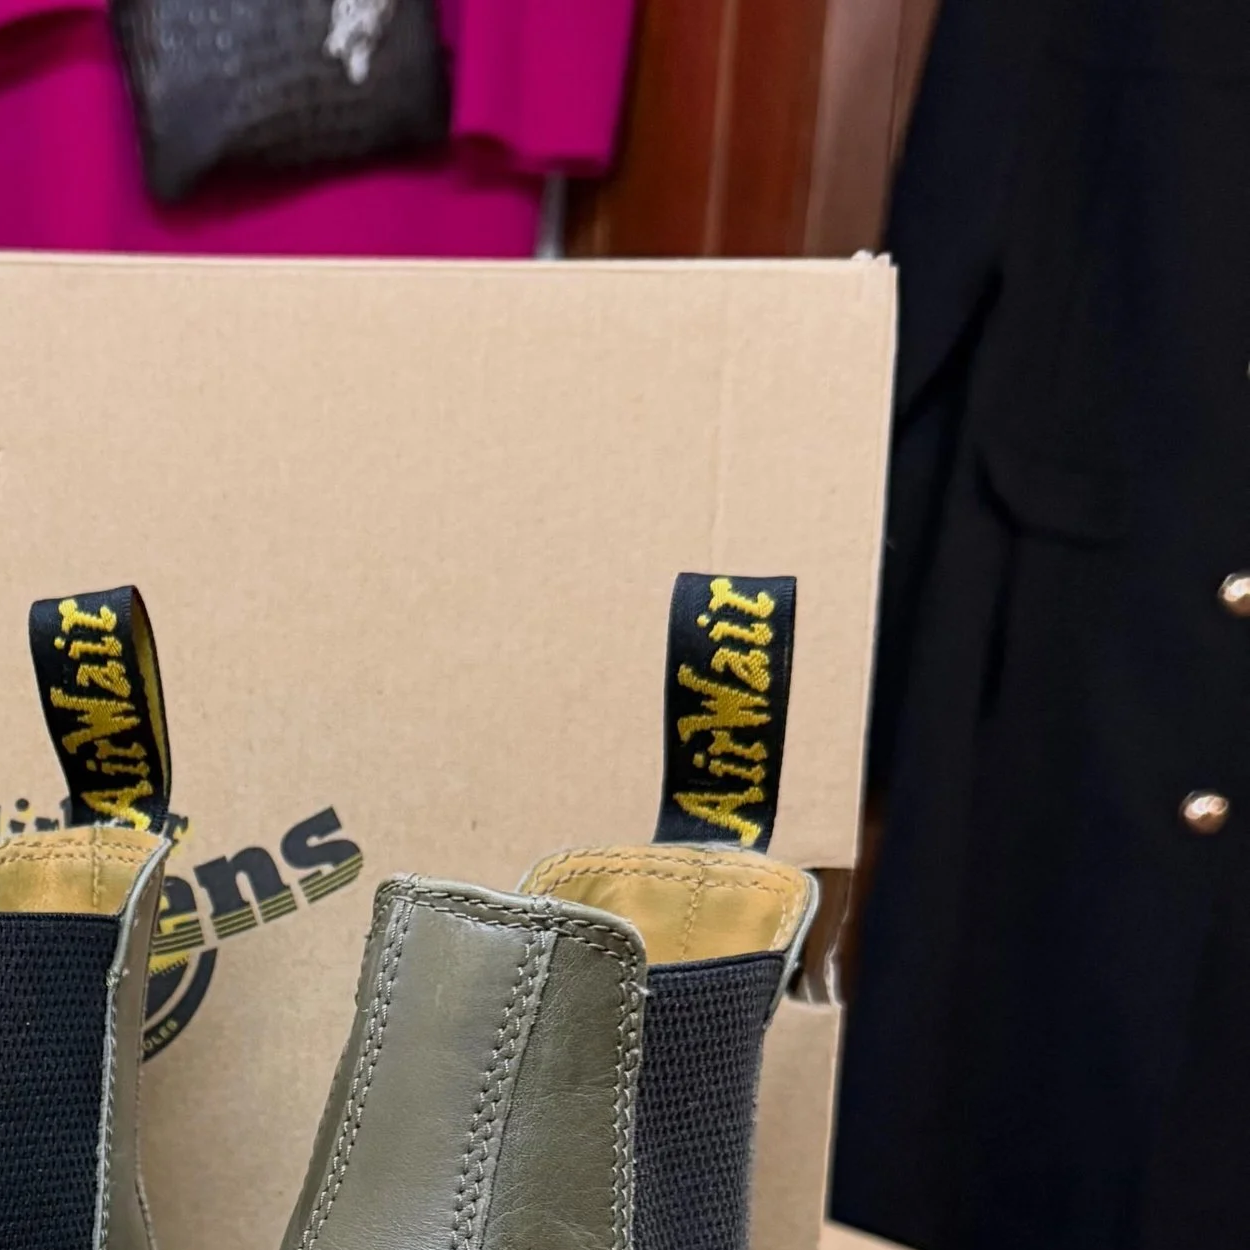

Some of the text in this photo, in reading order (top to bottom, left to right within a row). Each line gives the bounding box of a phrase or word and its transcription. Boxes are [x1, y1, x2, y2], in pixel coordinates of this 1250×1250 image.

[50, 598, 153, 832] AirWair
[672, 577, 775, 847] AirWair
[141, 1019, 179, 1051] OLES
